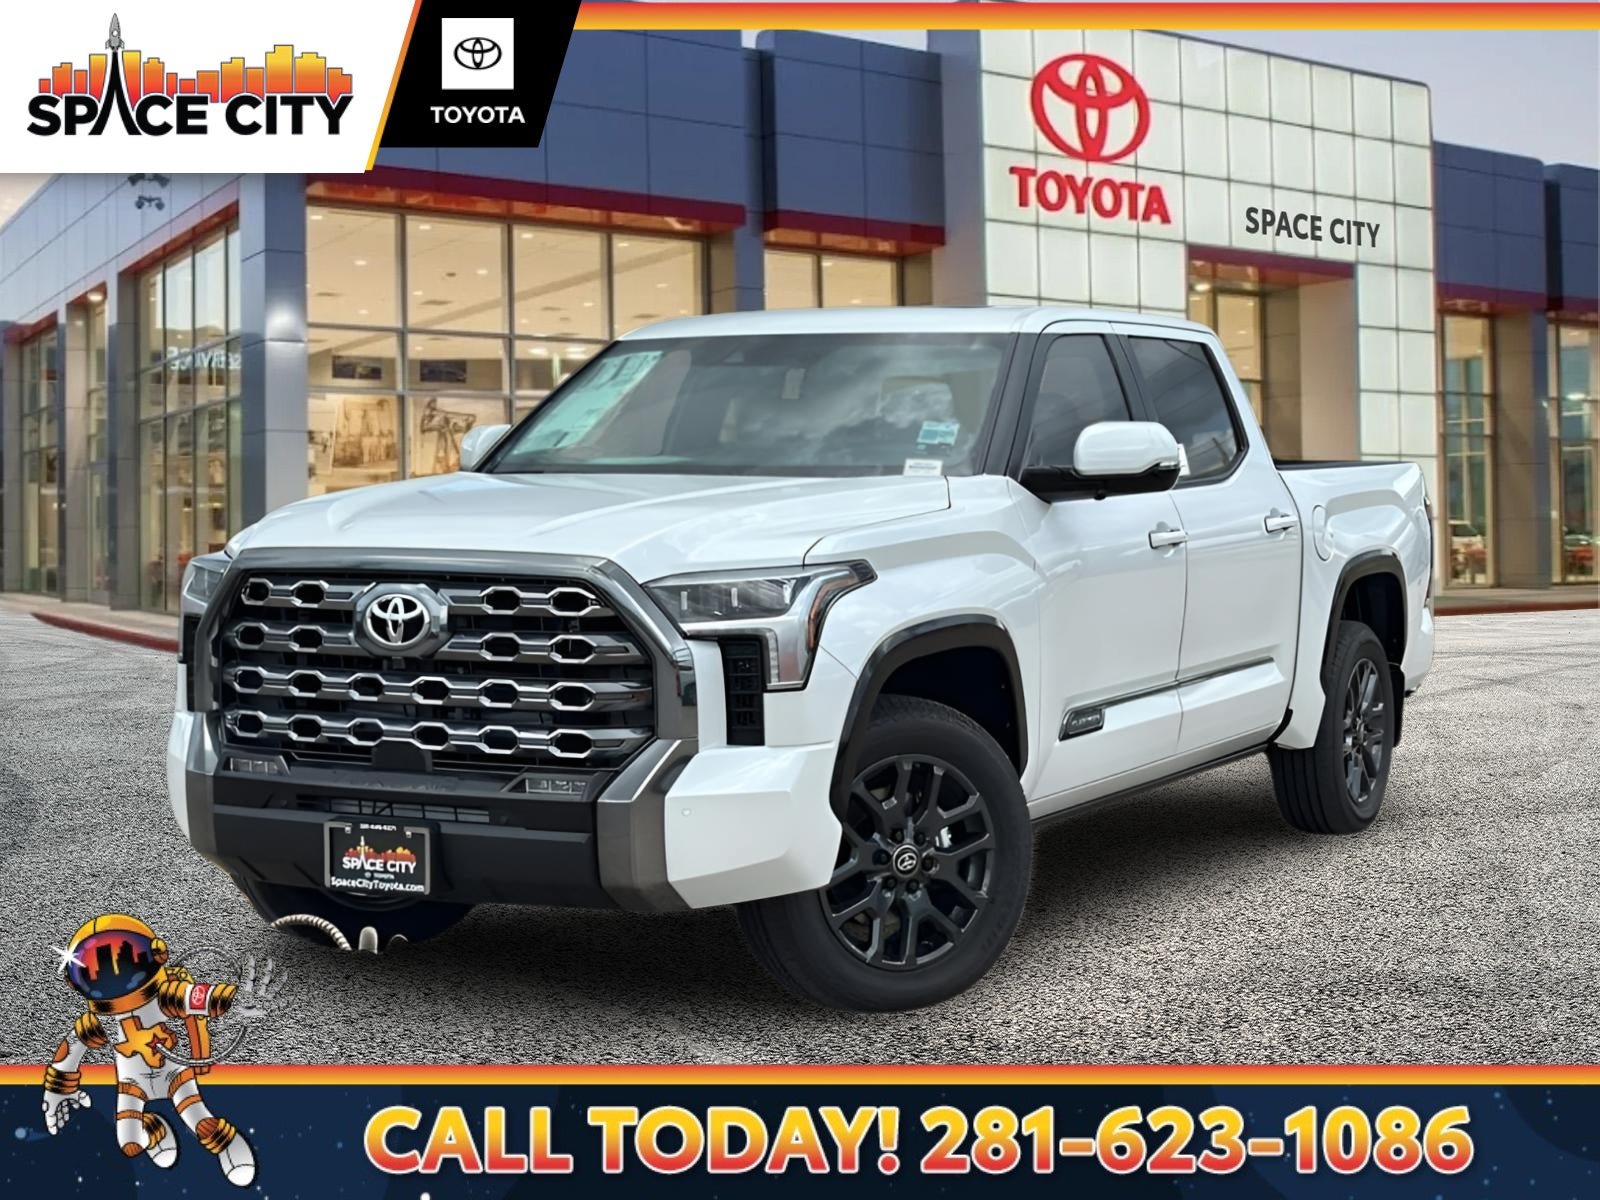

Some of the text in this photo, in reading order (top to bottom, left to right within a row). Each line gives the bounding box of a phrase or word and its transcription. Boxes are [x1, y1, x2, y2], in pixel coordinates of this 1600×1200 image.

[1009, 166, 1171, 224] TOYOTA
[1245, 206, 1380, 248] SPACE CITY
[342, 856, 417, 874] SPACE CITY
